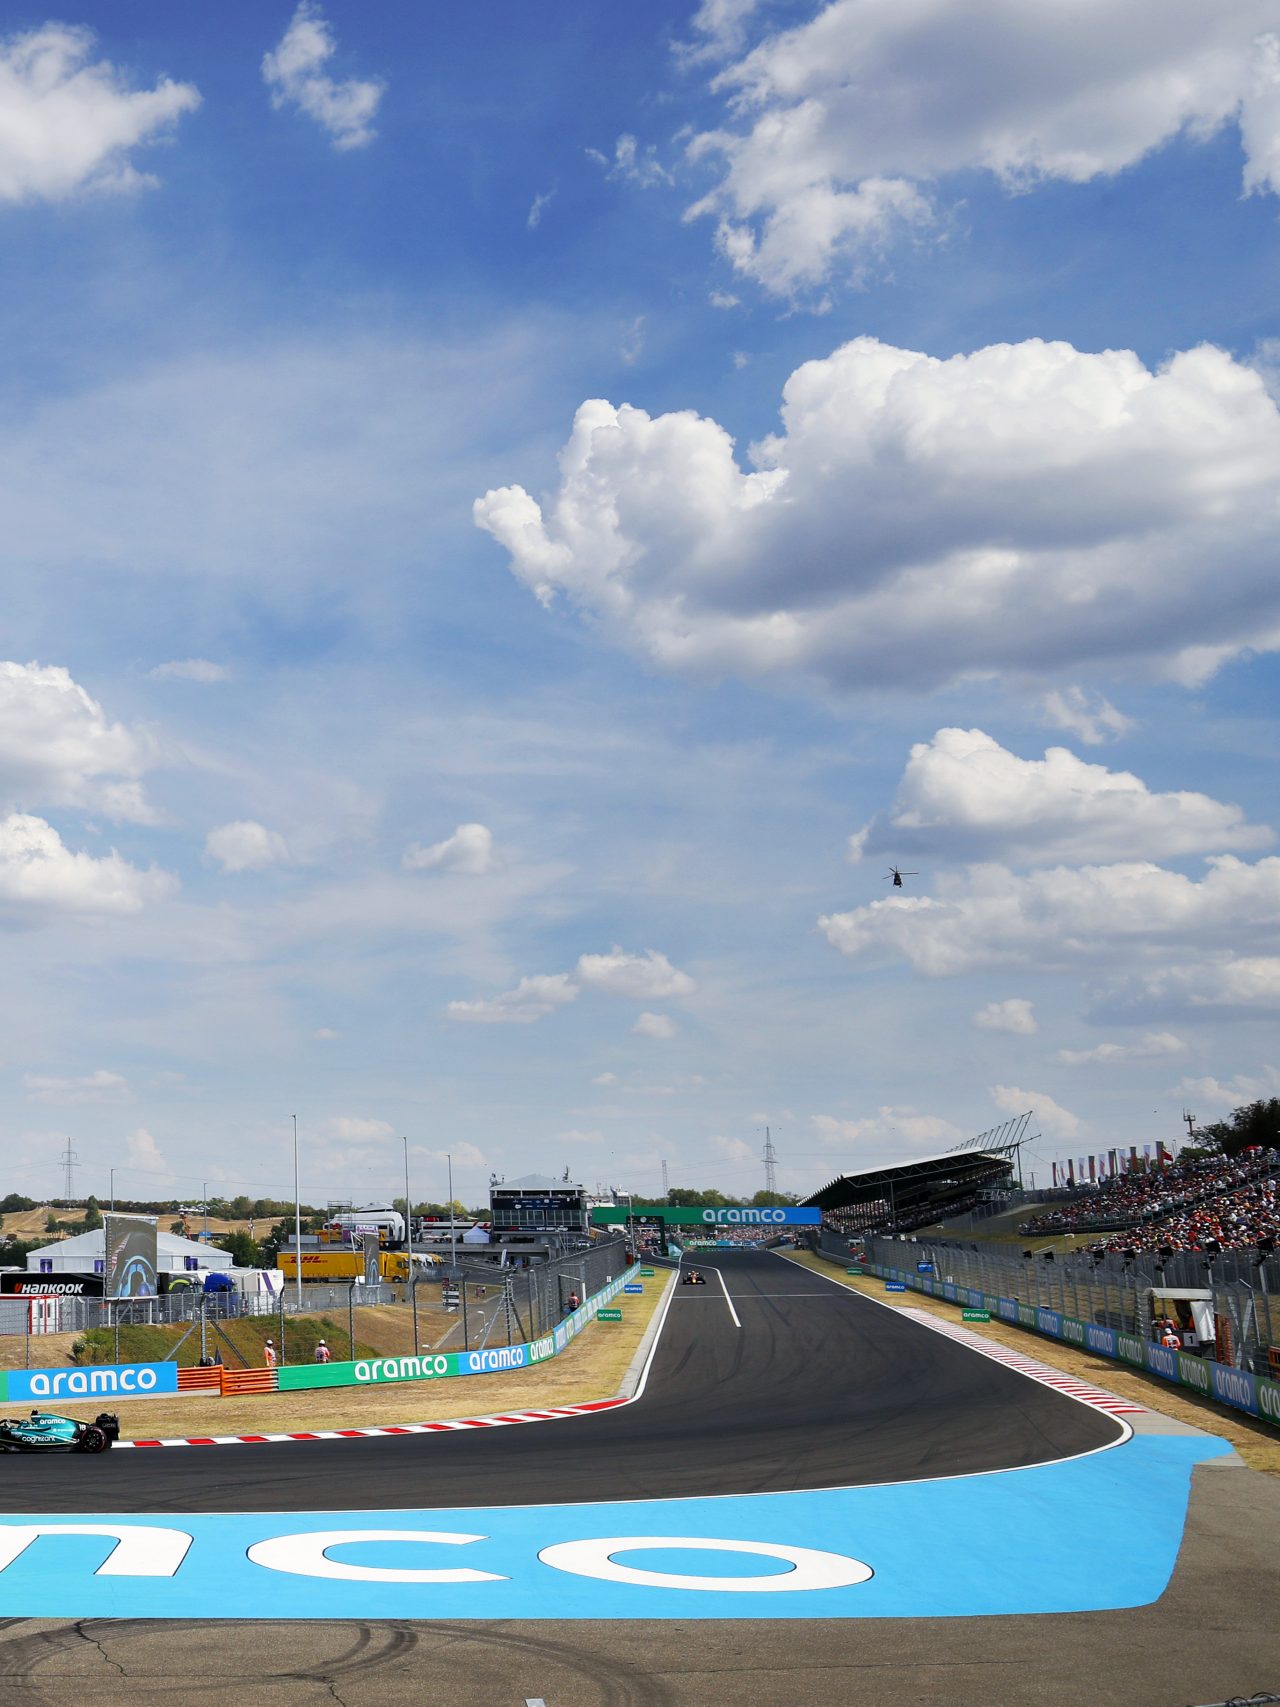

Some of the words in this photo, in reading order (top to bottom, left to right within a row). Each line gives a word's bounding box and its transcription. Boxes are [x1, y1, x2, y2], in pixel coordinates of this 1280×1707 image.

[703, 1209, 786, 1223] aramco
[963, 1311, 989, 1319] aramco
[469, 1348, 524, 1371] aramco
[530, 1337, 554, 1361] aramco
[354, 1355, 448, 1381] aramco
[1180, 1357, 1208, 1390] aramco
[29, 1368, 157, 1395] aramco
[1216, 1369, 1251, 1407] aramco
[22, 1435, 55, 1443] cognizant
